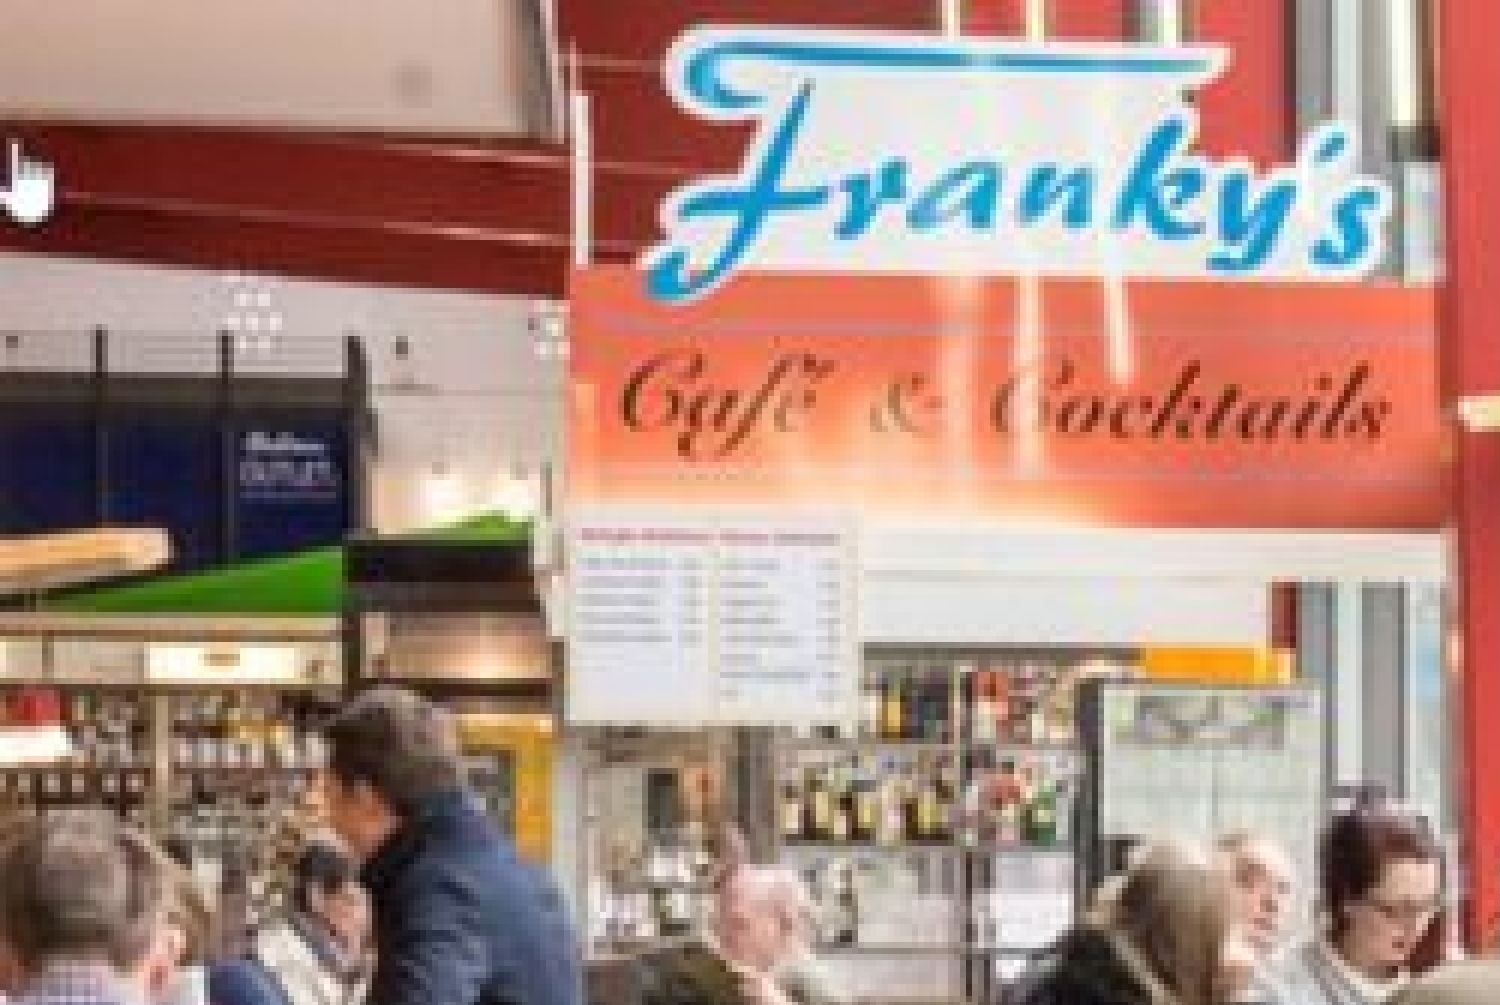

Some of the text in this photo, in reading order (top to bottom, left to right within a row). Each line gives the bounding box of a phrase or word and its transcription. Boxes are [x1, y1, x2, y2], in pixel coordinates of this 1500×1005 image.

[645, 38, 1385, 302] Franky's
[619, 350, 1393, 460] Café & Cocktails
